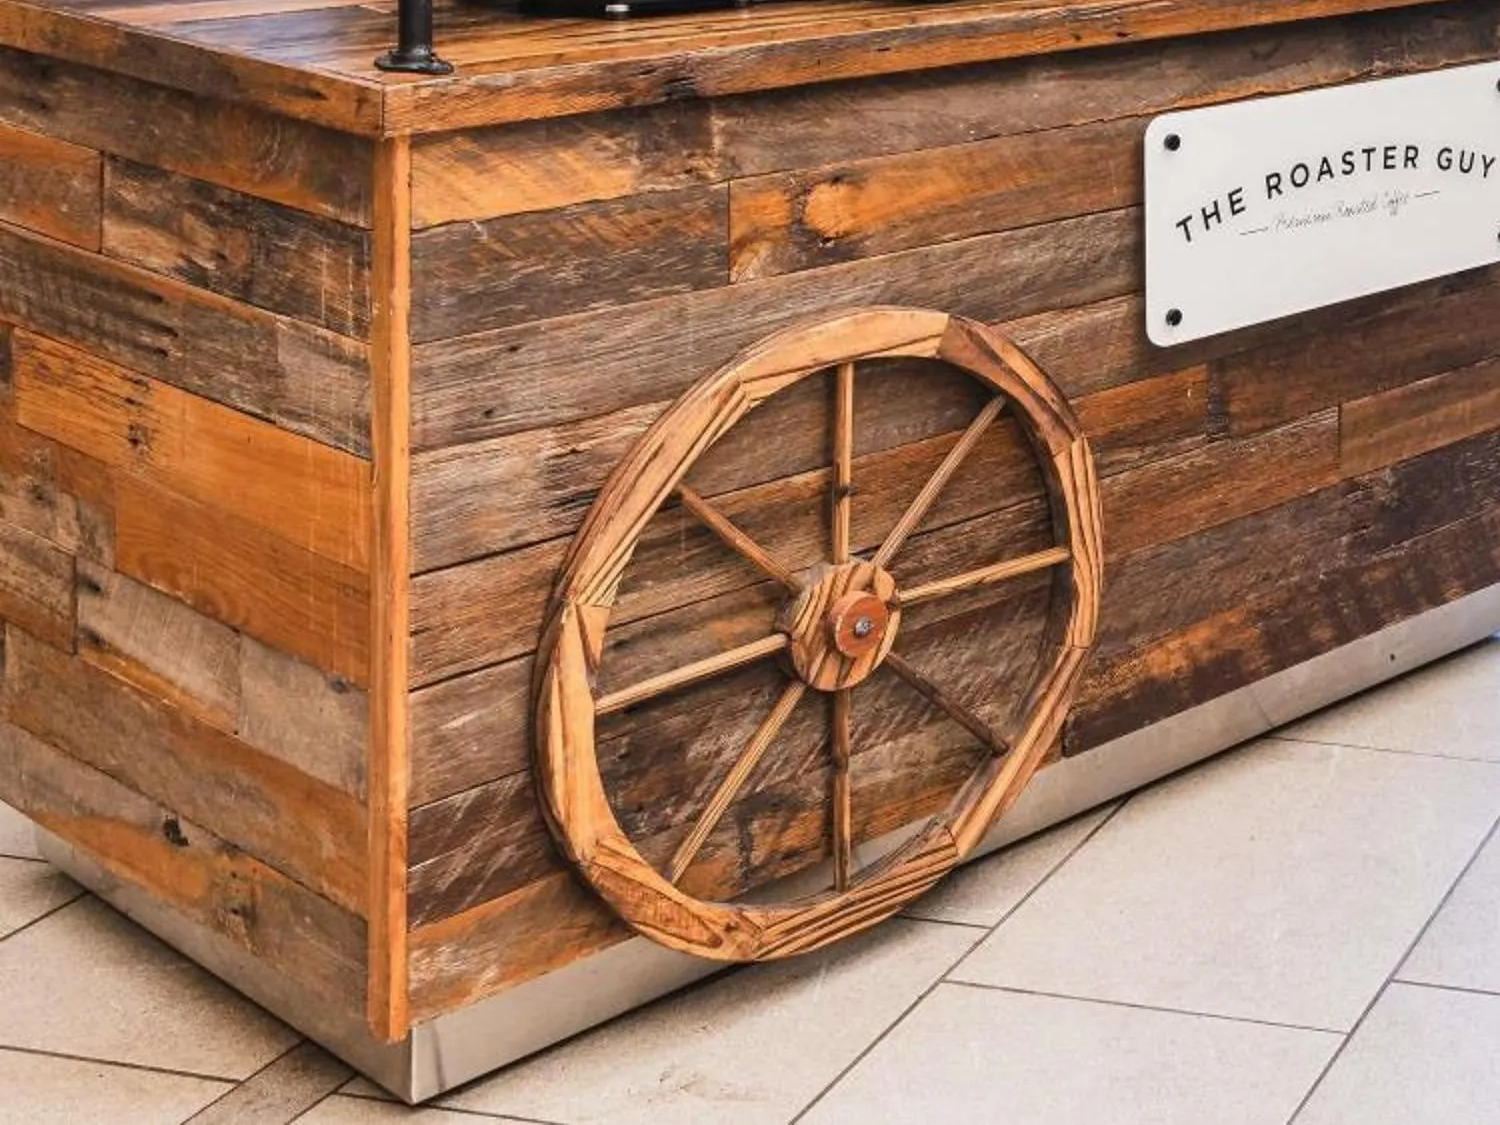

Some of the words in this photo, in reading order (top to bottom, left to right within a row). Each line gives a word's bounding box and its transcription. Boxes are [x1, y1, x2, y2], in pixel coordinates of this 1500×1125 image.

[1175, 187, 1248, 244] THE
[1265, 145, 1419, 200] ROASTER
[1436, 147, 1498, 179] GUY
